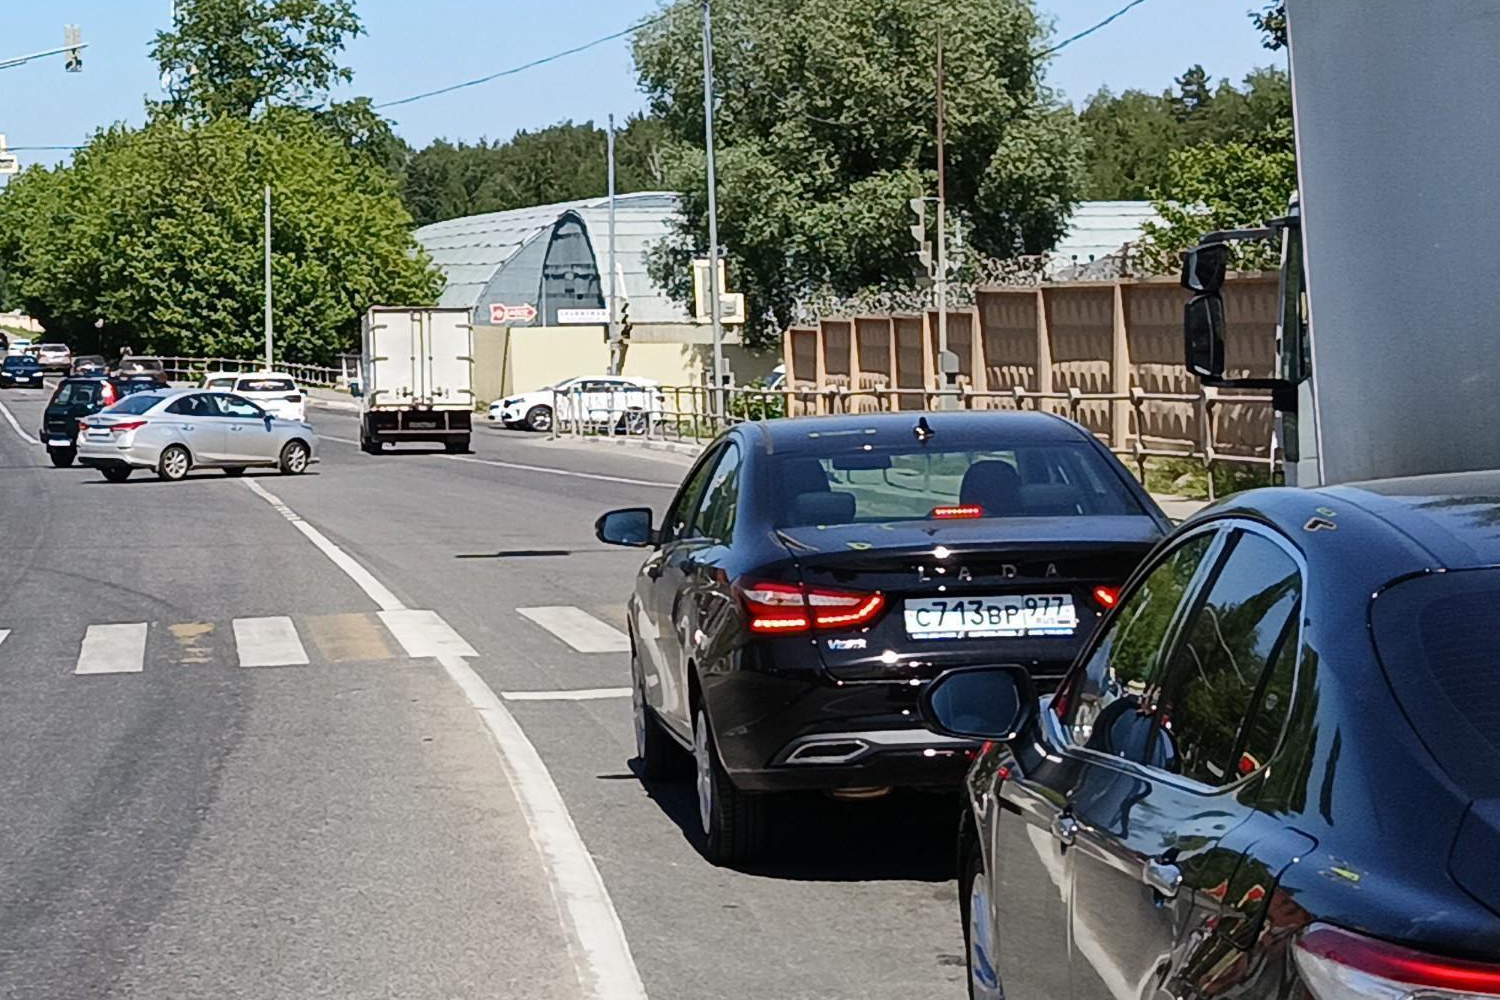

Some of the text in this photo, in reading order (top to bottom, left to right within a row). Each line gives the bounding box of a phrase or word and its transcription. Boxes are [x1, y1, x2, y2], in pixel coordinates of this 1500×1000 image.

[918, 563, 1057, 583] LADA
[916, 595, 1065, 627] С713ВР 977
